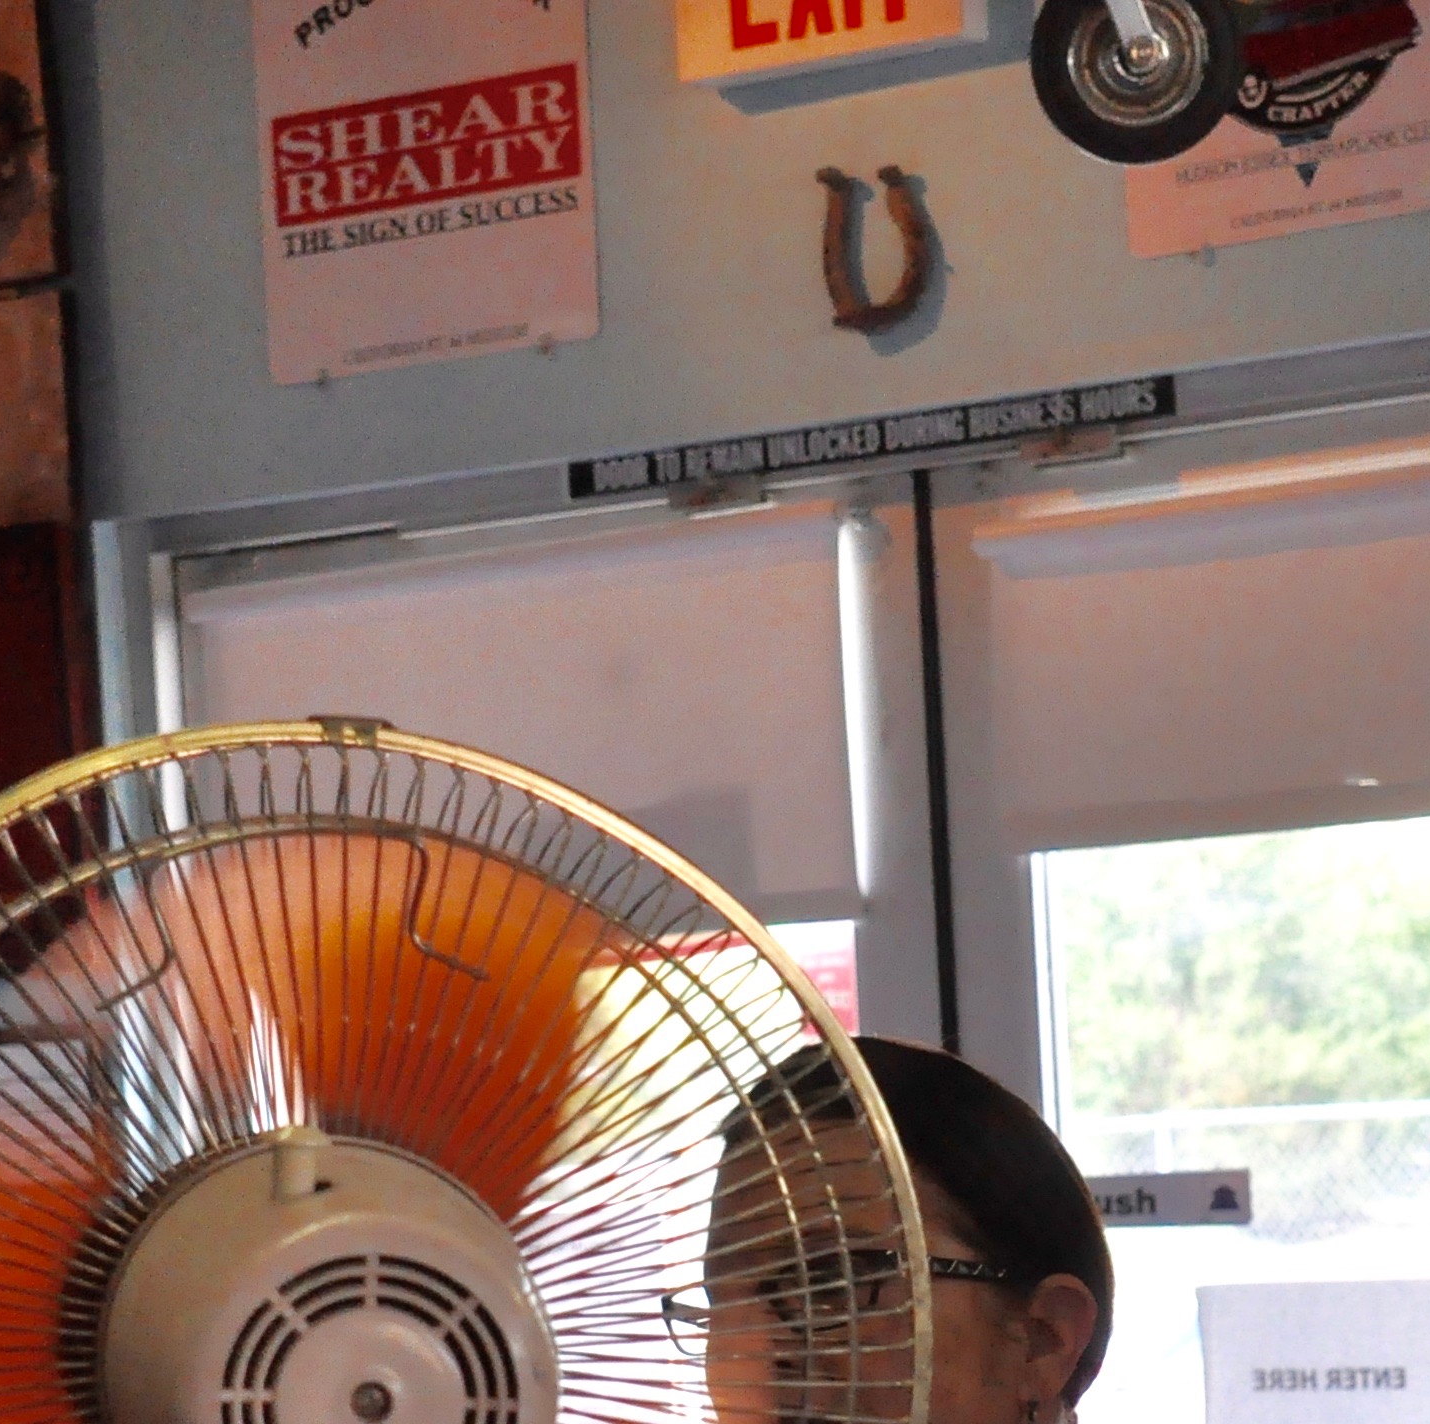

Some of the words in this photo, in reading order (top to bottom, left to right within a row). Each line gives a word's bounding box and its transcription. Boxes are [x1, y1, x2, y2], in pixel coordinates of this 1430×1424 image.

[277, 79, 572, 171] SHEAR
[282, 124, 572, 217] REALTY
[282, 229, 334, 259] THE
[344, 211, 408, 248] SIGN
[416, 207, 451, 235] OF
[457, 186, 579, 229] SUCCESS
[654, 449, 682, 487] TO
[767, 422, 881, 469] UNLOCKED
[885, 409, 966, 452] DURING
[967, 393, 1074, 439] BUSINESS
[1077, 381, 1158, 422] HOURS
